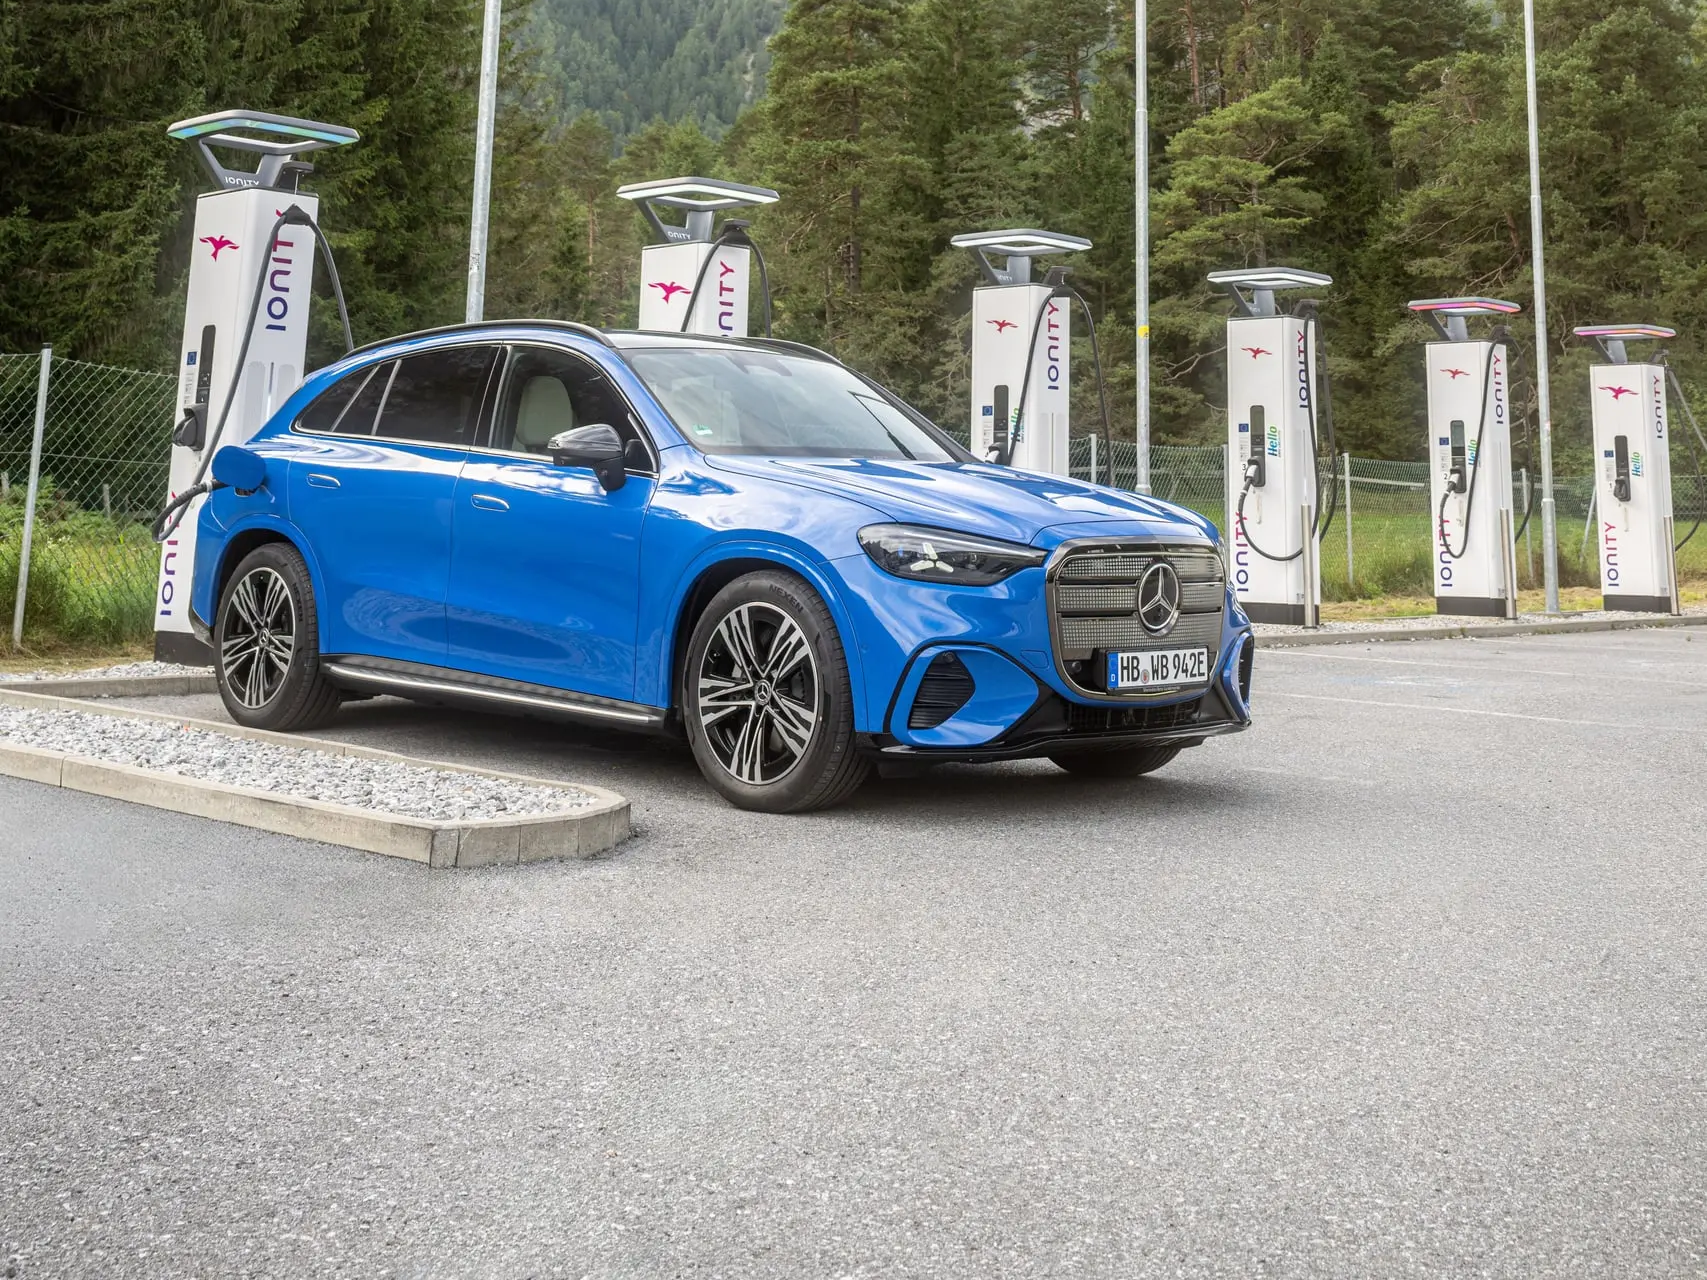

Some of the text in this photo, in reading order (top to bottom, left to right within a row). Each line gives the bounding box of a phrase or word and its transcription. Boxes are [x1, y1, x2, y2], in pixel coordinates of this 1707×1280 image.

[667, 231, 691, 241] ONITY
[265, 209, 294, 331] IONIT
[719, 260, 735, 336] NITY
[1047, 301, 1060, 390] IONITY
[1493, 353, 1504, 425] IONITY
[1653, 375, 1663, 439] IONITY
[1267, 425, 1278, 457] Hello
[1631, 451, 1641, 477] Hello
[160, 491, 180, 616] IONI
[1235, 511, 1249, 592] IONITY
[1604, 522, 1620, 587] IONITY
[769, 583, 804, 613] NEXEN
[1120, 651, 1205, 682] HB WB 942E
